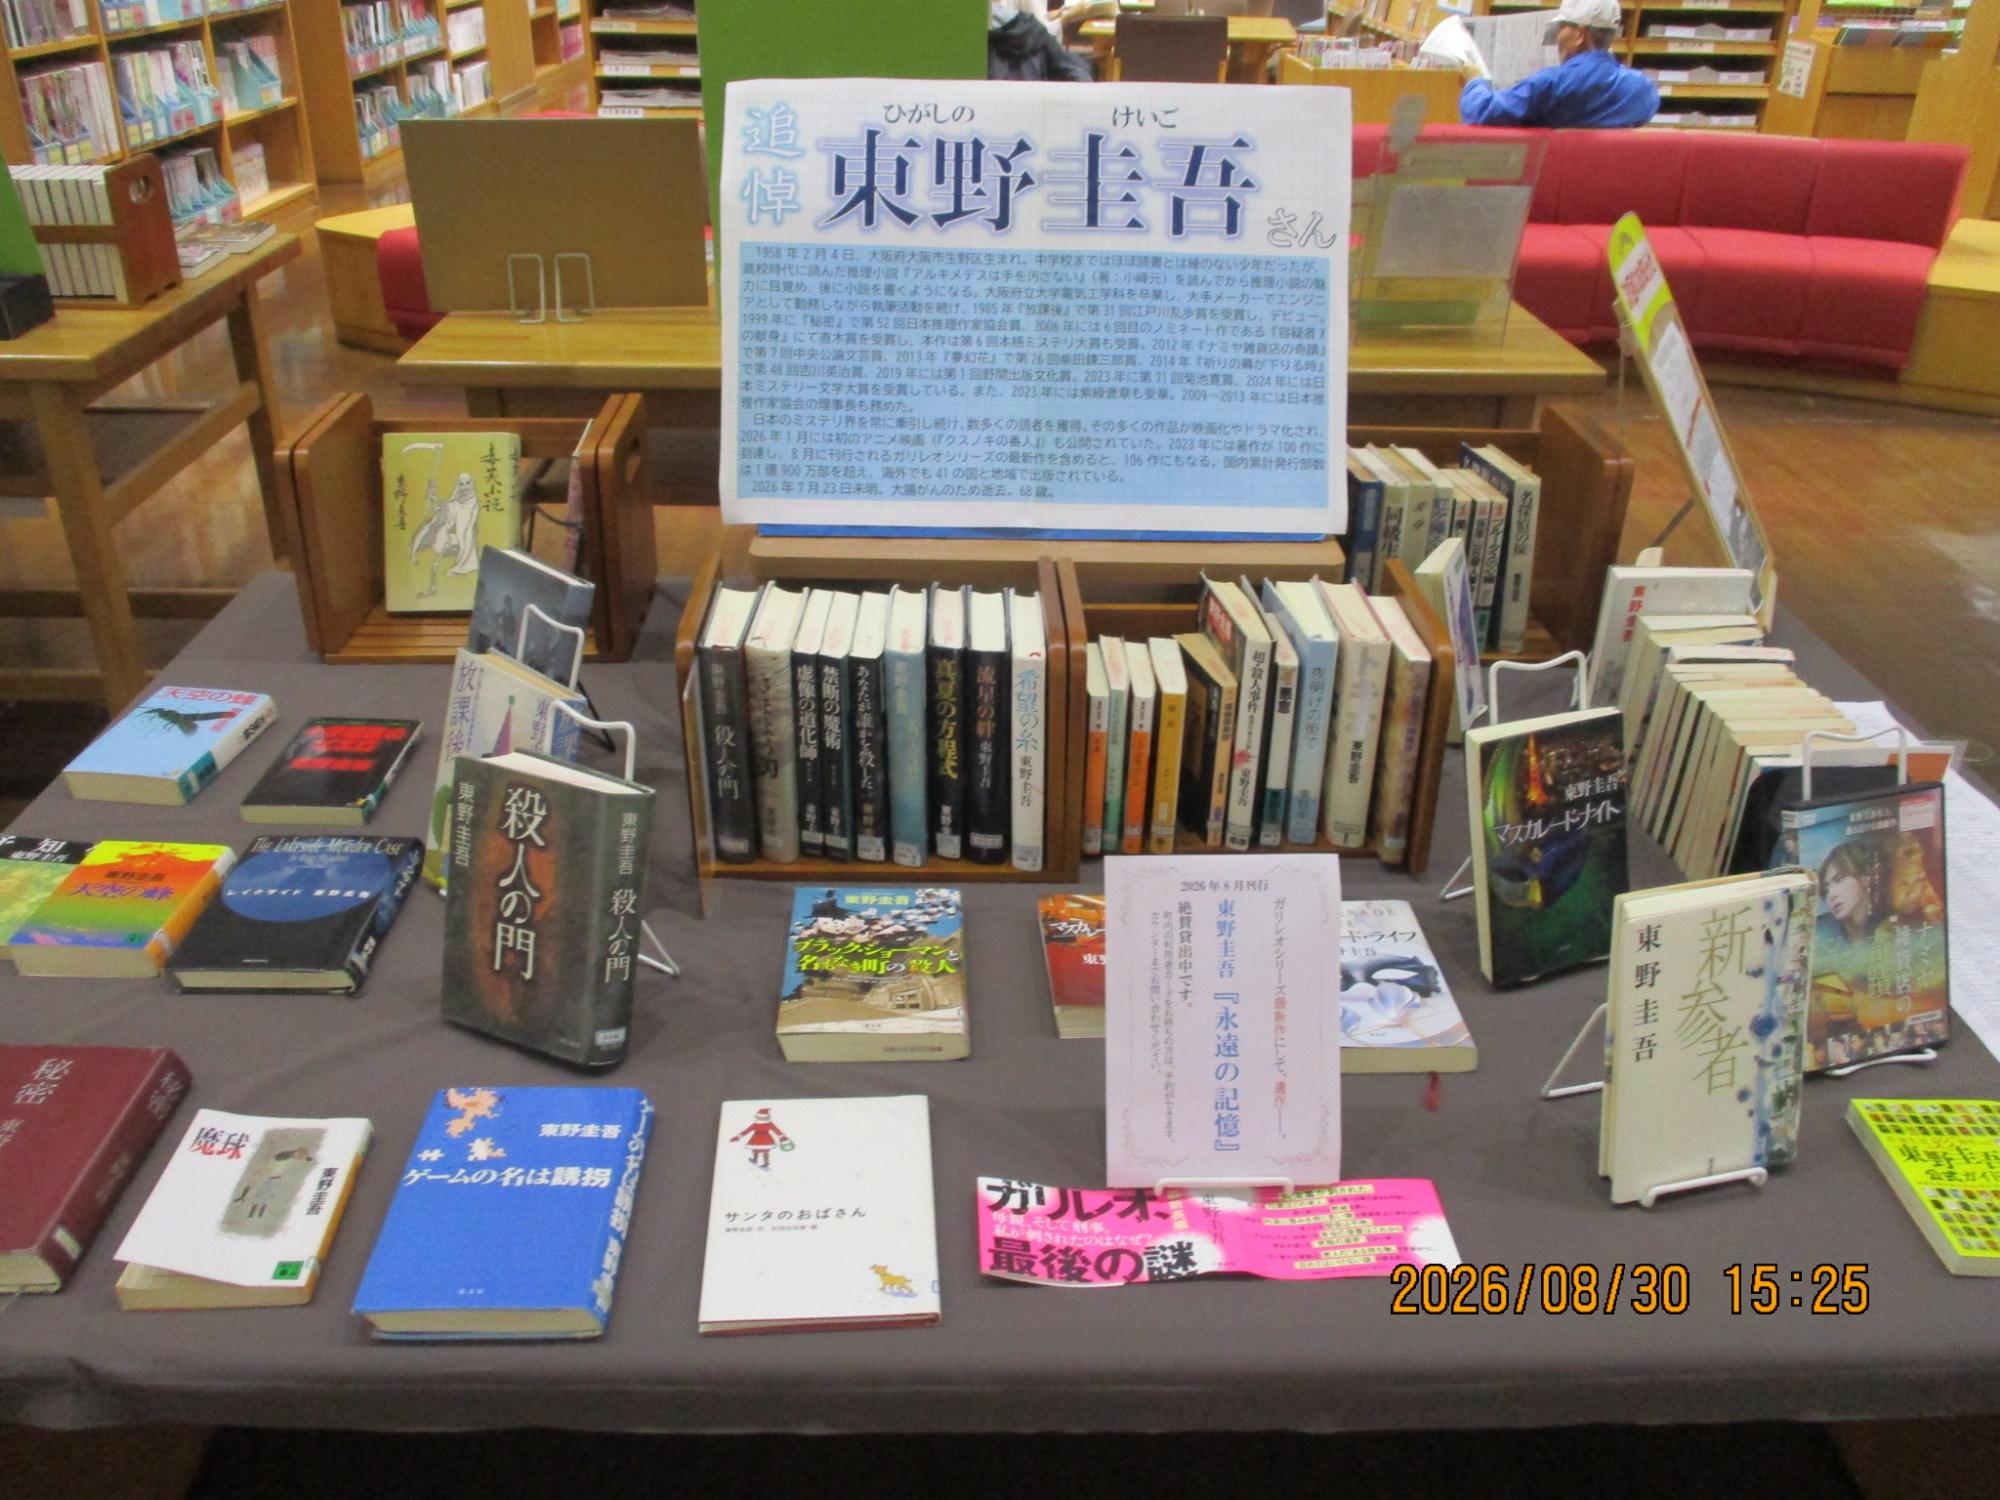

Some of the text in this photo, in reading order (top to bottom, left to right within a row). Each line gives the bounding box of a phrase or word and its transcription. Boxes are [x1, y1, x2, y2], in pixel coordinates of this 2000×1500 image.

[882, 102, 975, 125] ひがしの
[1113, 104, 1180, 130] けいご
[741, 104, 804, 227] 追悼
[817, 127, 1261, 240] 東野圭吾
[1263, 205, 1338, 251] さん
[797, 664, 819, 761] 虚像の道化師
[822, 664, 842, 750] 禁断の魔術
[855, 664, 876, 791] あなたが誰かを殺した
[934, 658, 959, 780] 真夏の方程式
[974, 665, 997, 740] 流星の絆
[1016, 667, 1040, 754] 希望の糸
[1304, 665, 1326, 751] 夜明けの街で
[713, 722, 739, 801] 殺人の門
[1018, 753, 1034, 809] 東野圭吾
[1565, 774, 1619, 803] 東野圭吾
[454, 781, 475, 867] 東野圭吾
[617, 811, 639, 875] 東野圭吾
[1493, 799, 1622, 848] マスカレード・ナイト
[491, 785, 548, 982] 殺人の門
[1180, 877, 1270, 893] 2026年8月刊行
[604, 888, 638, 984] 殺人の門
[1178, 900, 1194, 1009] 絶賛貸出中です。
[1631, 923, 1663, 1064] 東野圭吾
[1673, 904, 1754, 1096] 新参者
[14, 1057, 75, 1105] 秘密
[190, 1126, 252, 1160] 魔球
[539, 1122, 624, 1139] 東野圭吾
[402, 1165, 613, 1189] ゲームの名は誘拐
[725, 1207, 867, 1223] サンタのおばさん
[992, 1212, 1111, 1235] 母親、そして刑事。
[988, 1236, 1199, 1282] 最後の謎
